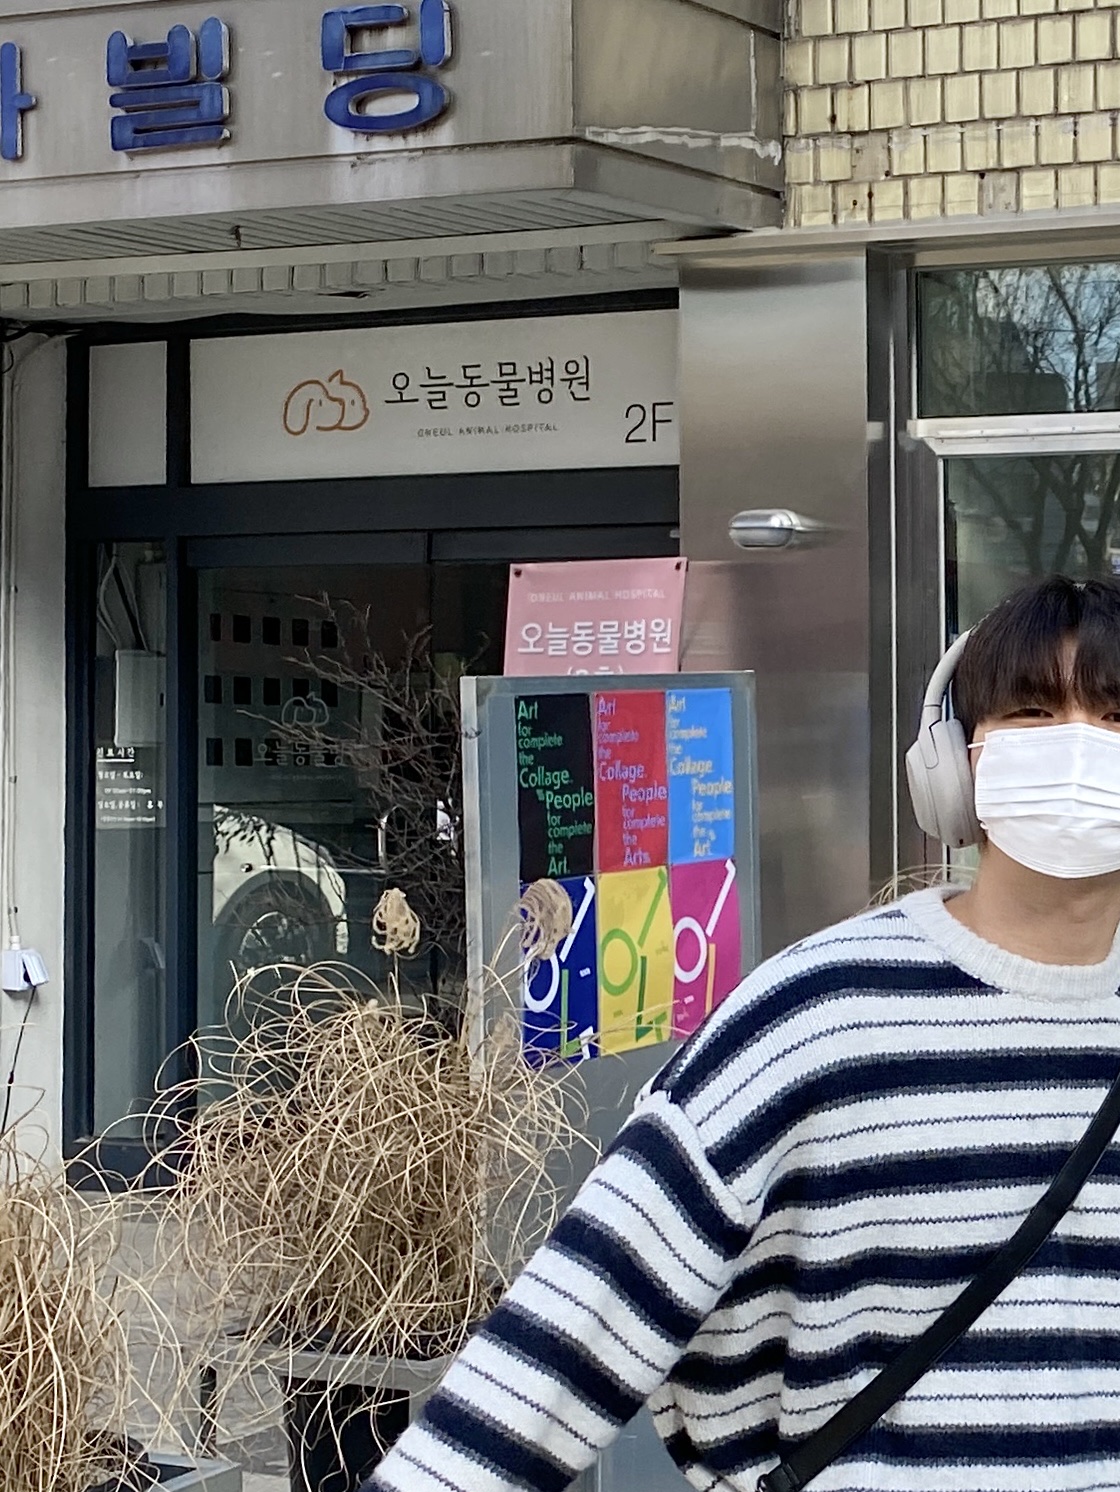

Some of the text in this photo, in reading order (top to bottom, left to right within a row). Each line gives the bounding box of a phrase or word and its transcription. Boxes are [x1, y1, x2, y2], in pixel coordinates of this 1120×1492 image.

[385, 355, 591, 410] 오늘동물병원
[505, 422, 559, 434] HOSPITAL
[625, 402, 674, 443] 2F
[614, 588, 666, 600] HOSPITAL
[517, 617, 672, 656] 오늘동물병원
[518, 701, 539, 720] Art
[518, 733, 563, 750] complete
[545, 787, 594, 812] People
[622, 781, 667, 806] People
[691, 776, 733, 800] People
